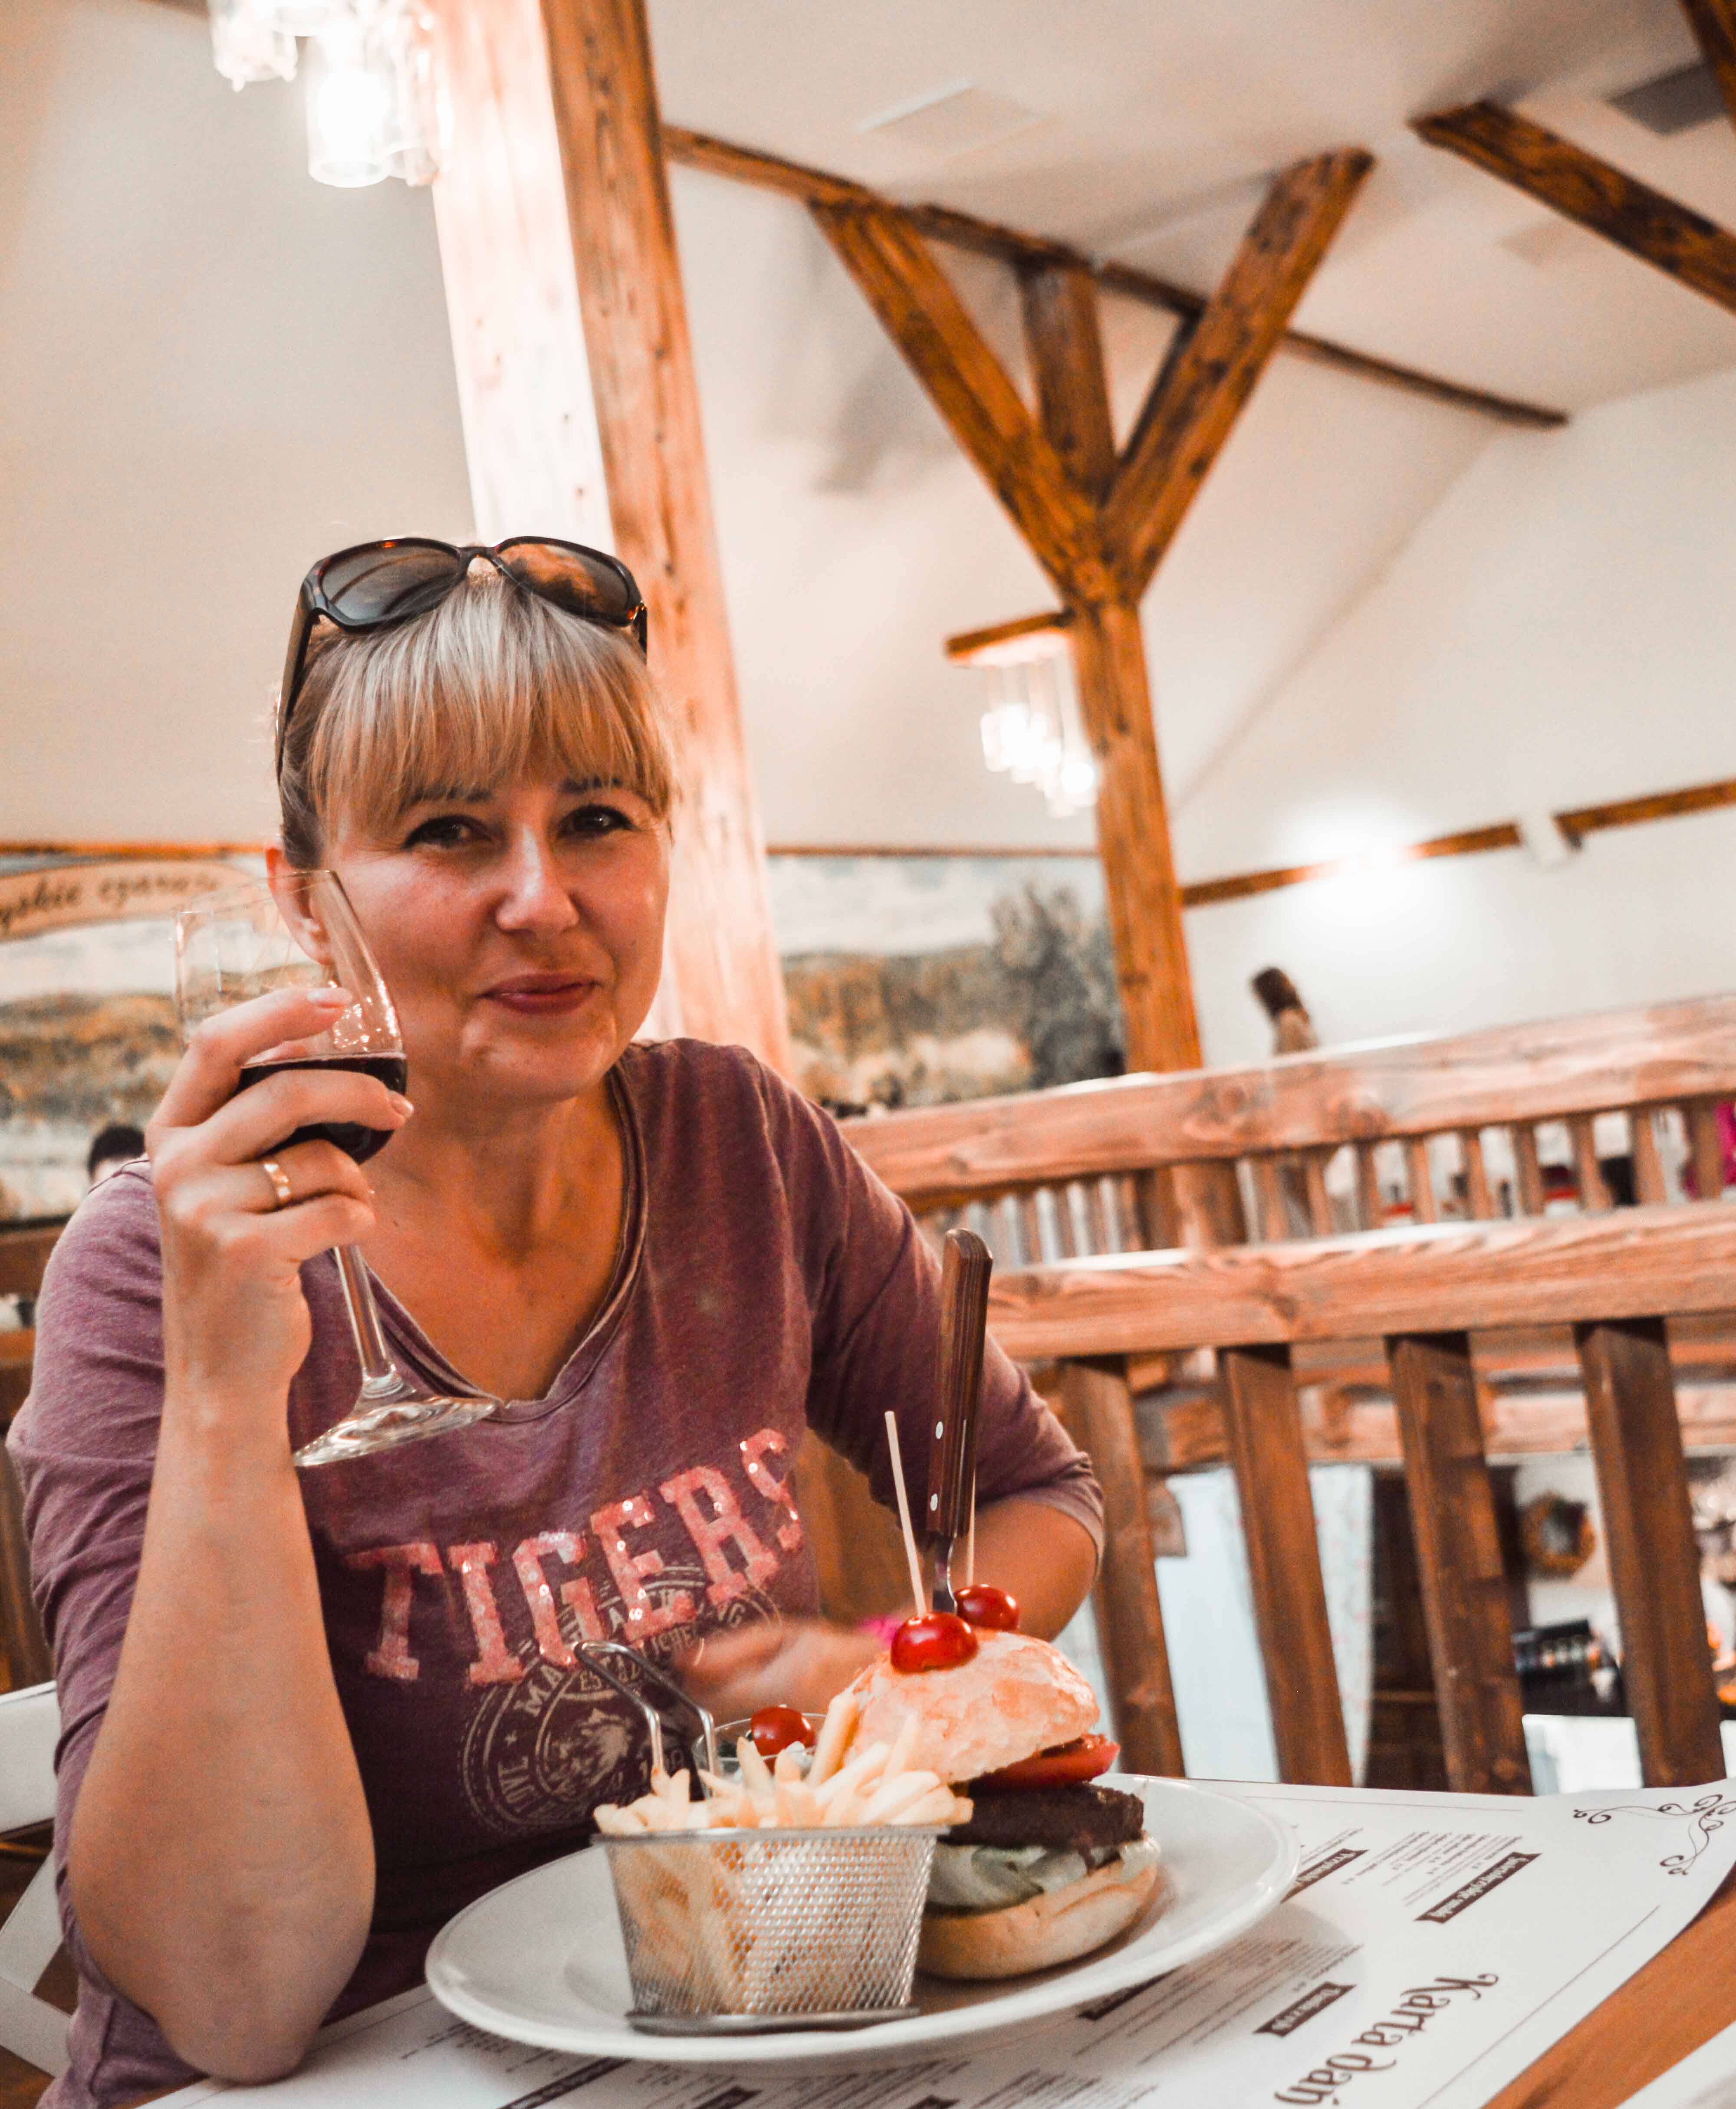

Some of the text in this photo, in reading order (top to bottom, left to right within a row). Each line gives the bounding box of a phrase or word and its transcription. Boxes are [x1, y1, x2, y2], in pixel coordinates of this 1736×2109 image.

[346, 1428, 803, 1685] TIGERS
[1274, 1973, 1499, 2106] Karta dań
